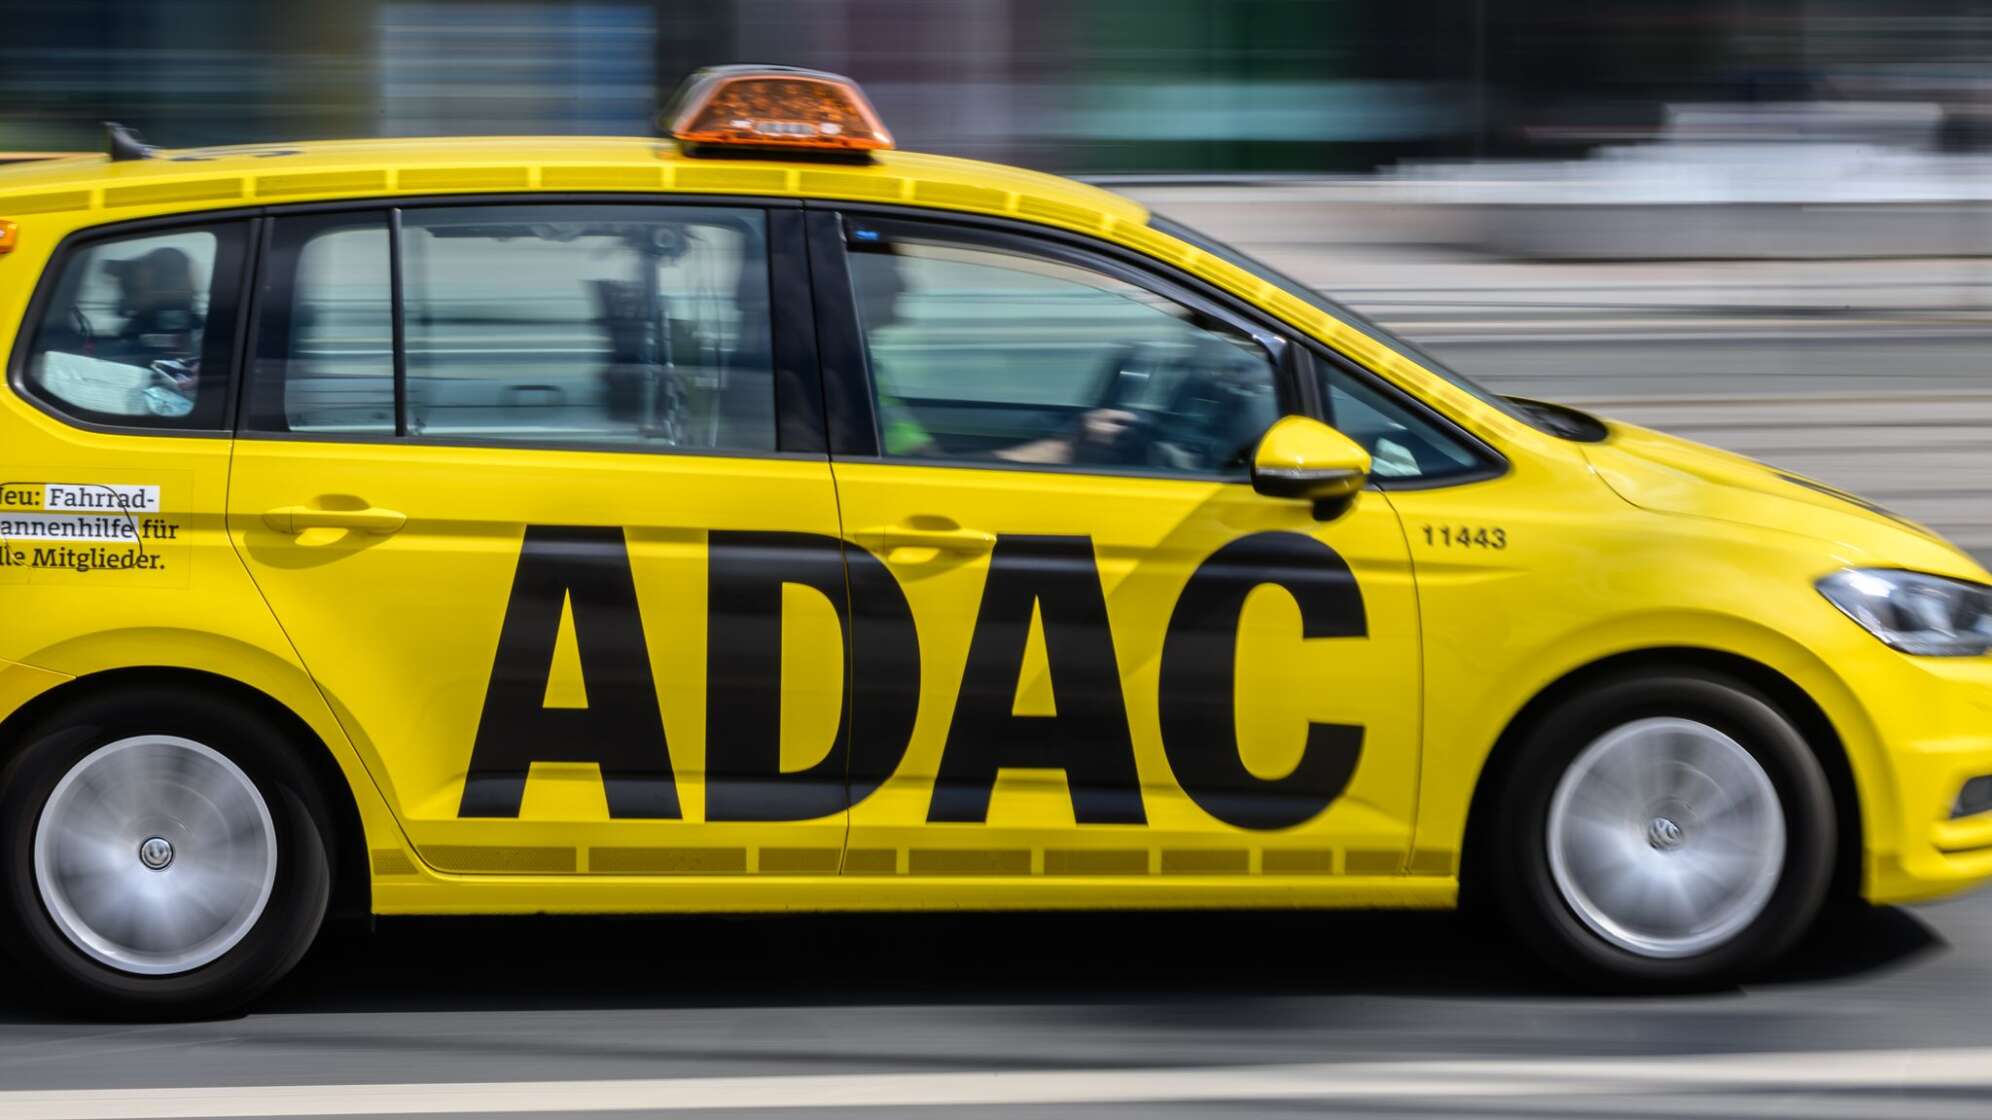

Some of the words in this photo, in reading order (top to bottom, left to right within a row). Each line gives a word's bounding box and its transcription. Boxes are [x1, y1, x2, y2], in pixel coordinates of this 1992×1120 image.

[0, 486, 40, 507] eu:
[49, 487, 154, 509] Fahrrad-
[0, 517, 134, 539] annenhilfe
[142, 519, 180, 540] für
[1422, 525, 1507, 550] 11443
[0, 545, 25, 567] lle
[32, 546, 166, 573] Mitglieder.
[457, 524, 1369, 832] ADAC
